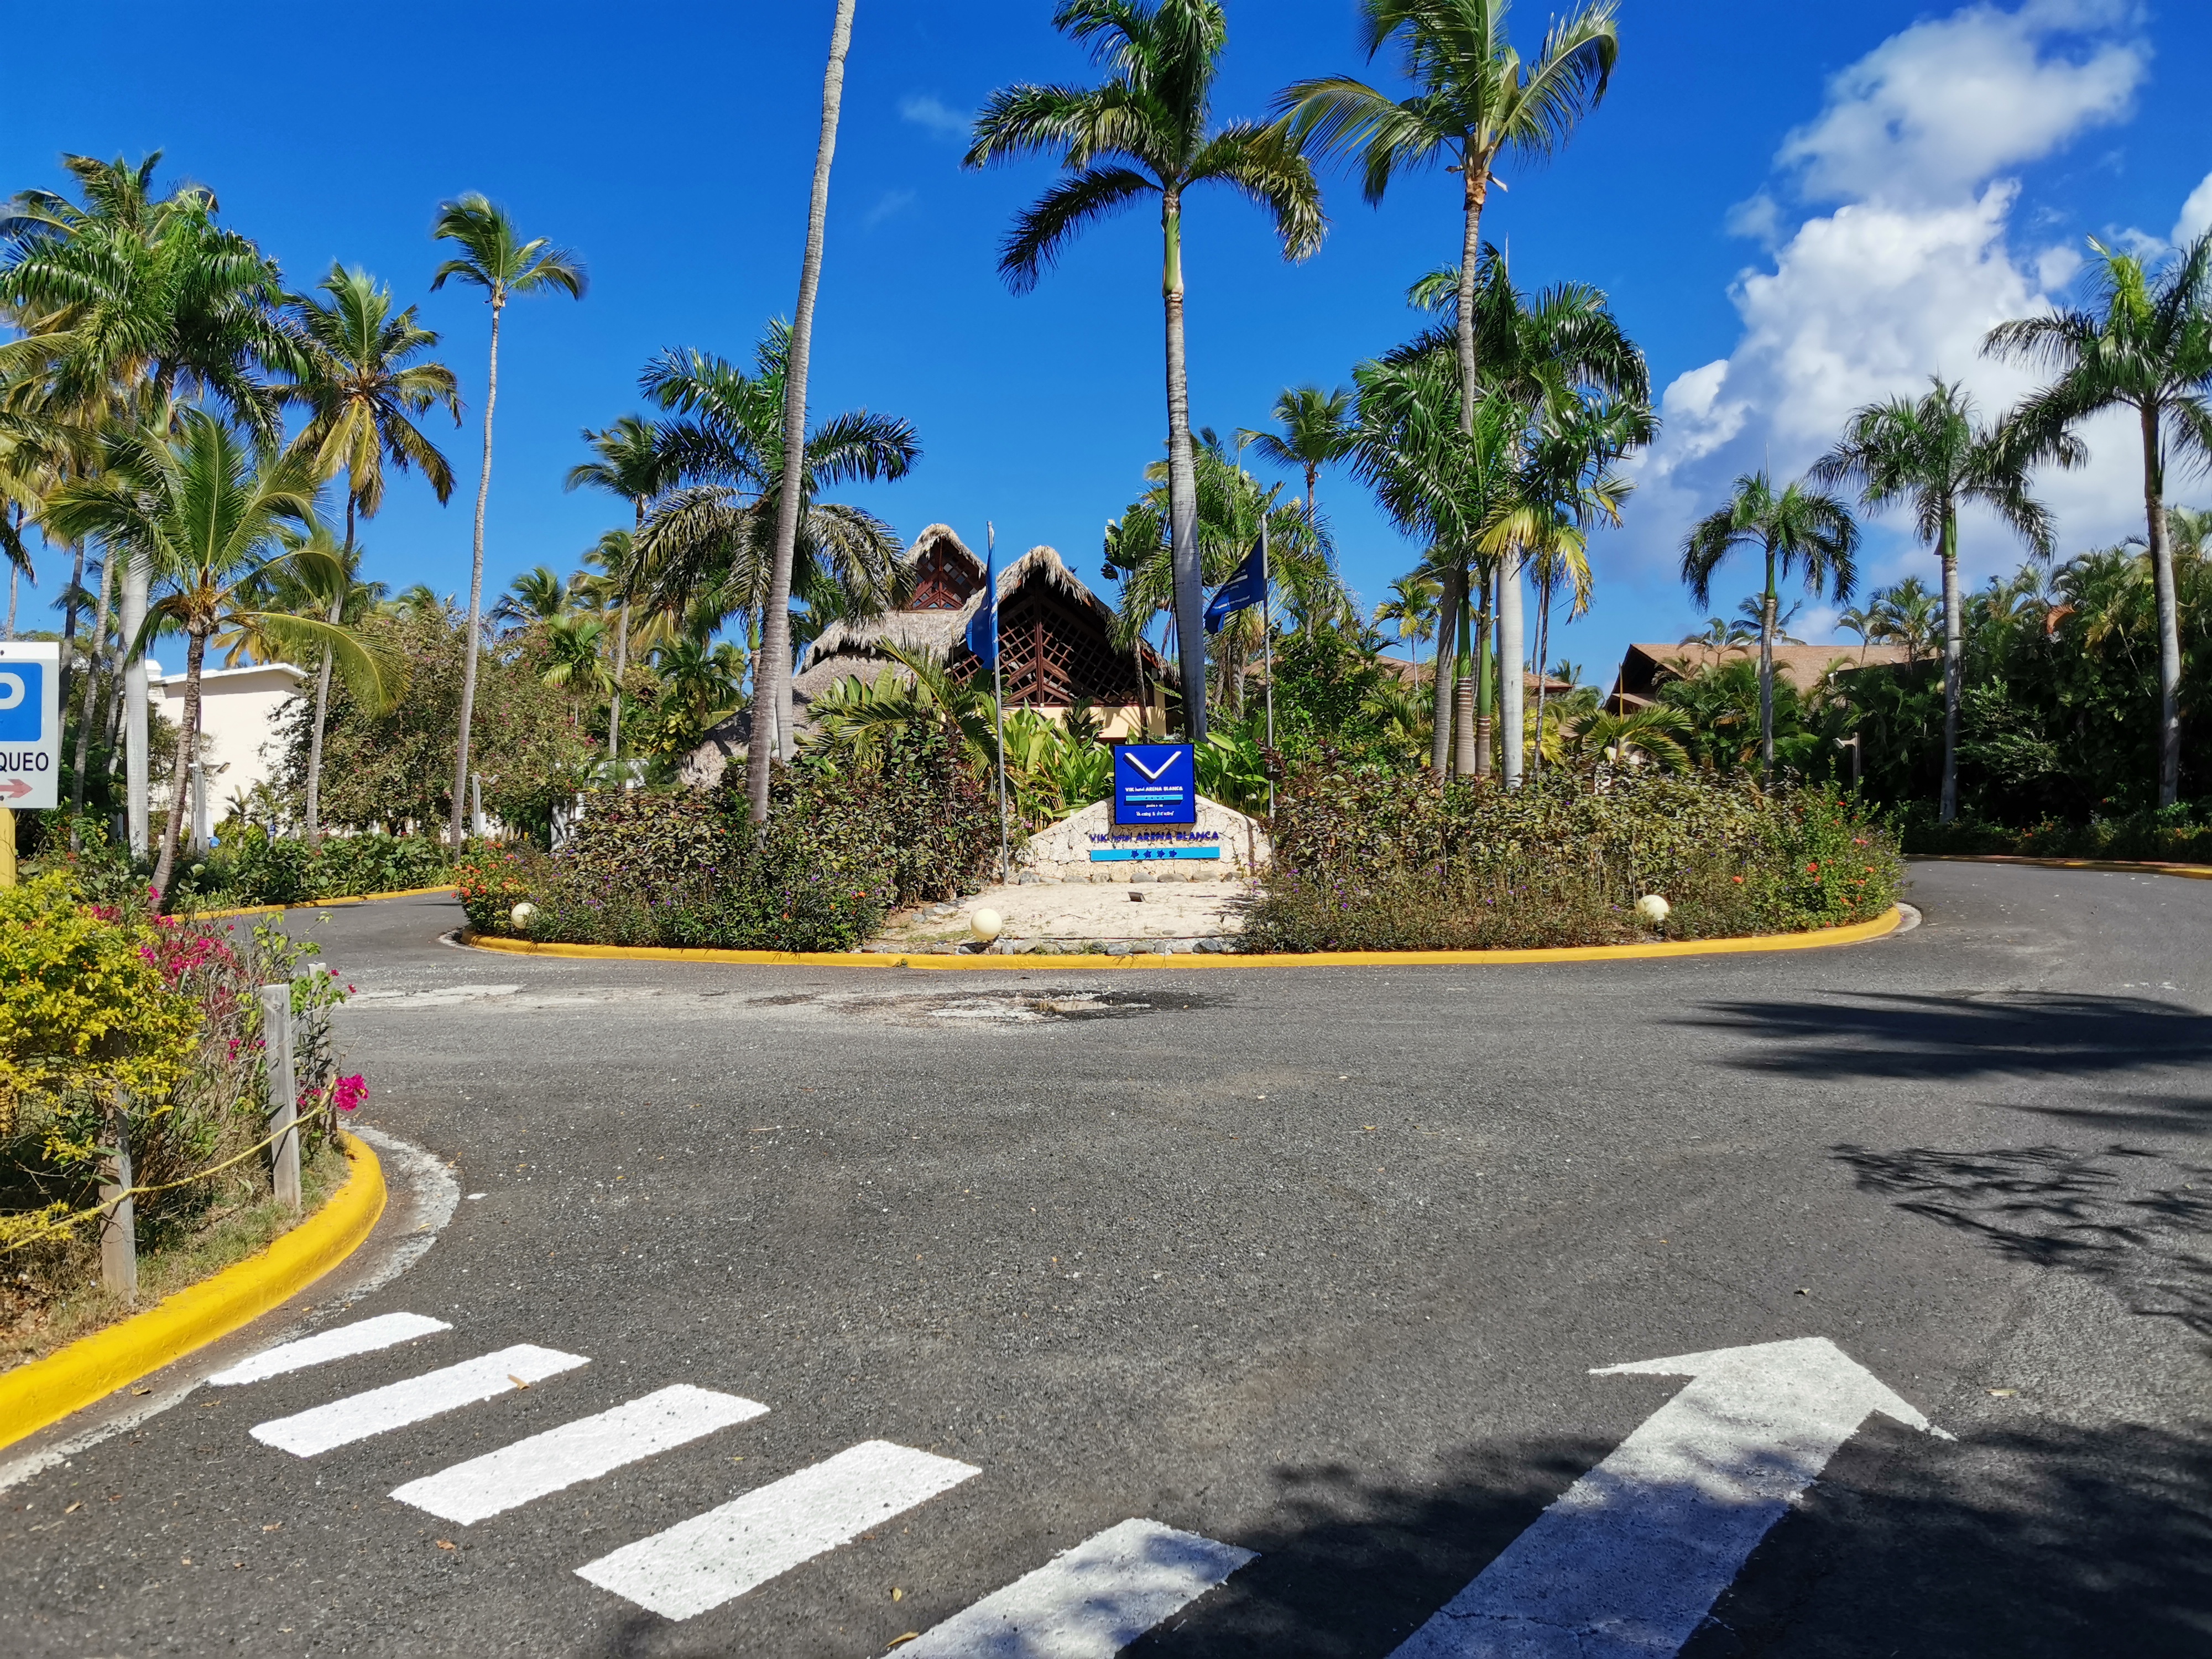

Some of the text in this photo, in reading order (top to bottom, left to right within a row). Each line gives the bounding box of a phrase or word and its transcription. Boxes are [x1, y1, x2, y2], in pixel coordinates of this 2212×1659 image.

[1089, 834, 1109, 842] VIK
[1136, 832, 1172, 841] ARENA
[1176, 831, 1219, 841] BLANCA
